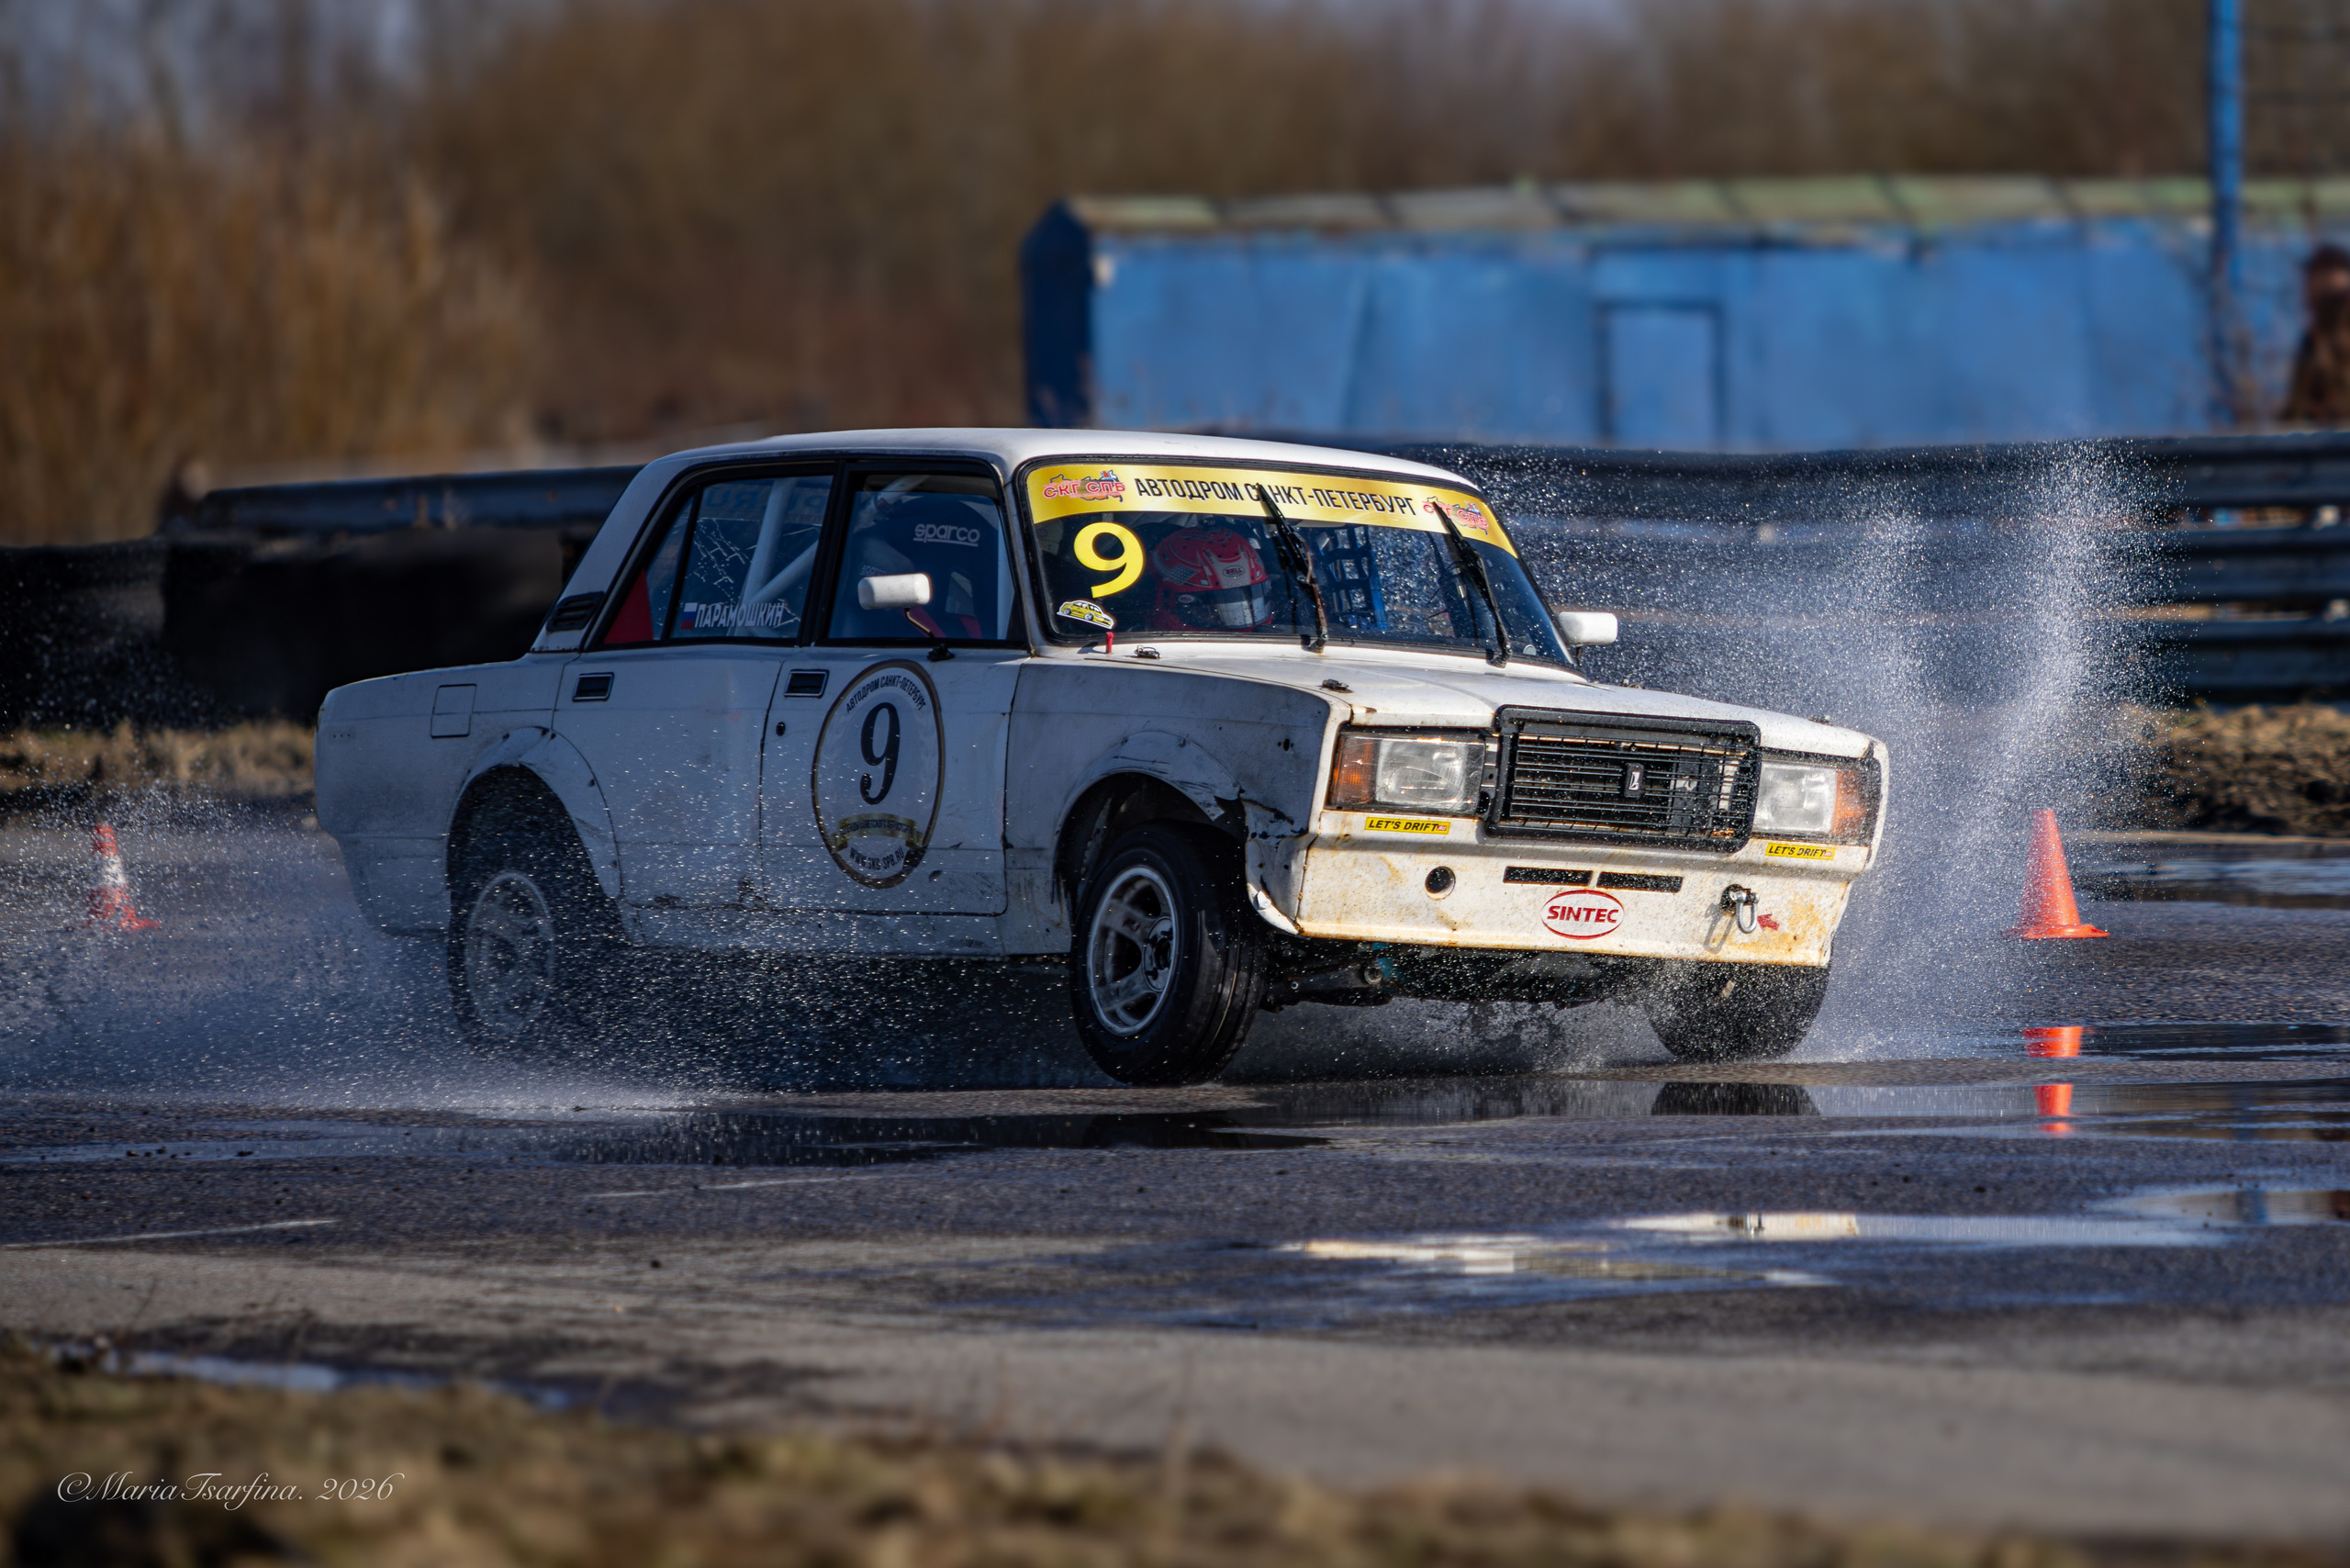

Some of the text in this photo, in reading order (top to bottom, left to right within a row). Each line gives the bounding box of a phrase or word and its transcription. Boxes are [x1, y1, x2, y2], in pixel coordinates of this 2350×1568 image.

[1043, 482, 1080, 499] СКГ
[1085, 481, 1126, 494] СПБ
[1135, 478, 1416, 516] АВТОДРОМ СНКТ-ПЕТЕРБУРГ
[1423, 504, 1452, 518] СГ
[914, 522, 980, 544] sparco
[1073, 521, 1146, 599] 9
[1225, 566, 1244, 575] BELL
[694, 602, 785, 628] ПАРАМОШКИН
[845, 675, 926, 713] АВТОДРОМ САНКТ-ПЕТЕРБУРГ
[859, 701, 901, 805] 9
[1368, 819, 1401, 830] LET'S
[1403, 822, 1438, 832] DRIFT
[1769, 846, 1796, 856] LET'S
[1796, 847, 1827, 857] DRIFT
[1547, 905, 1619, 923] SINTEC
